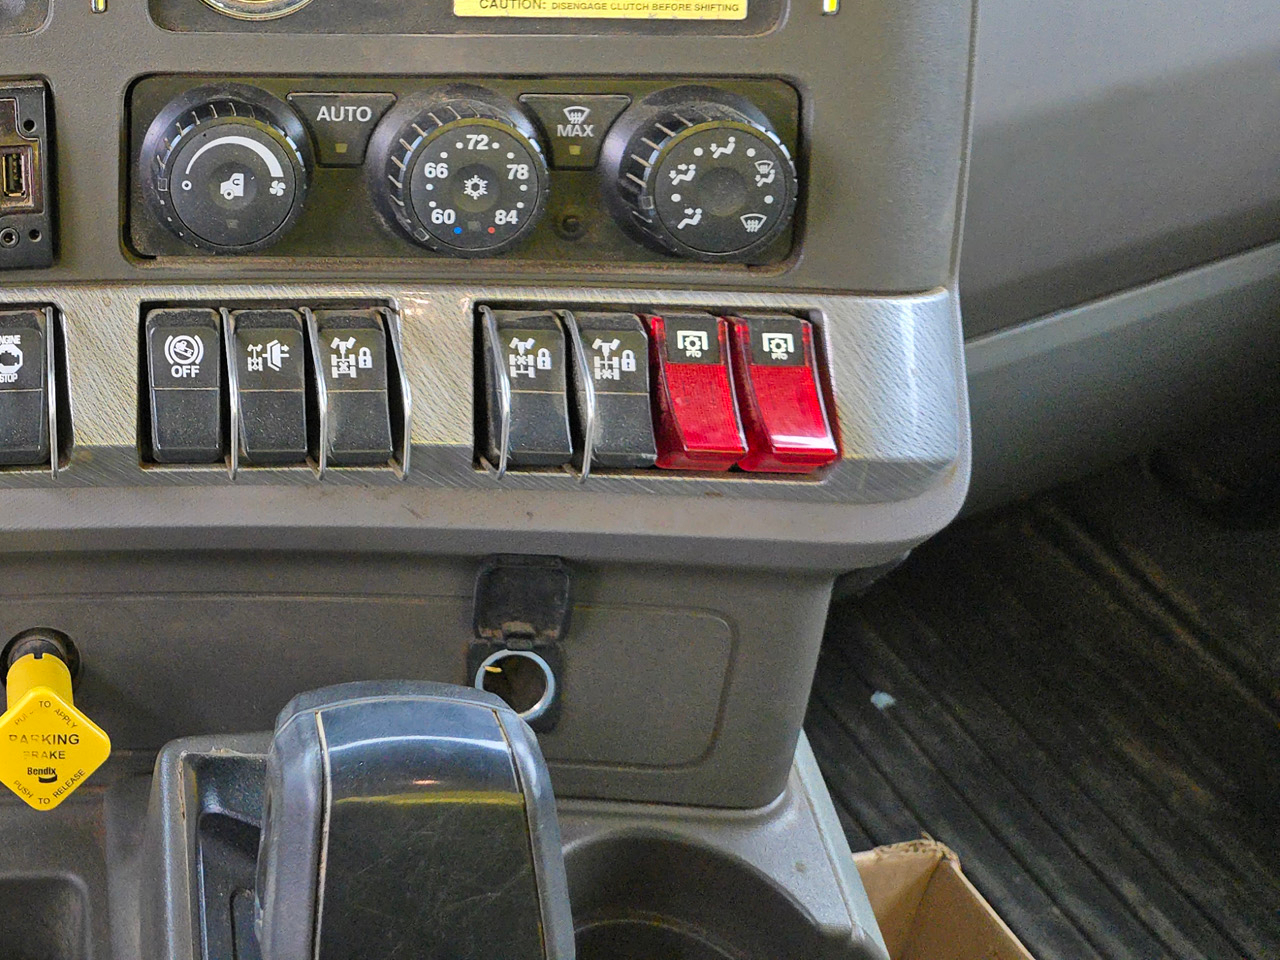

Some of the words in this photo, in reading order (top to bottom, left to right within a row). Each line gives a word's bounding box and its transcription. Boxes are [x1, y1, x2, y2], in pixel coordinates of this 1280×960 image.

[551, 2, 607, 10] DISENGAGE
[610, 2, 649, 11] CLUTCH
[652, 3, 692, 11] BEFORE
[694, 3, 739, 12] SHIFTING
[317, 106, 371, 122] AUTO
[557, 124, 594, 138] MAX
[466, 134, 489, 150] 72
[424, 162, 448, 178] 66
[506, 164, 529, 180] 78
[431, 209, 456, 225] 60
[494, 209, 518, 225] 84
[685, 350, 702, 358] PTO
[771, 352, 788, 360] PTO
[0, 373, 18, 383] STOP
[171, 365, 200, 378] OFF
[14, 711, 36, 725] PUL
[54, 708, 78, 728] APPLY
[9, 734, 80, 745] PARKING
[27, 767, 57, 776] Bendix
[13, 780, 34, 798] PUSH
[53, 769, 86, 798] RELEASE
